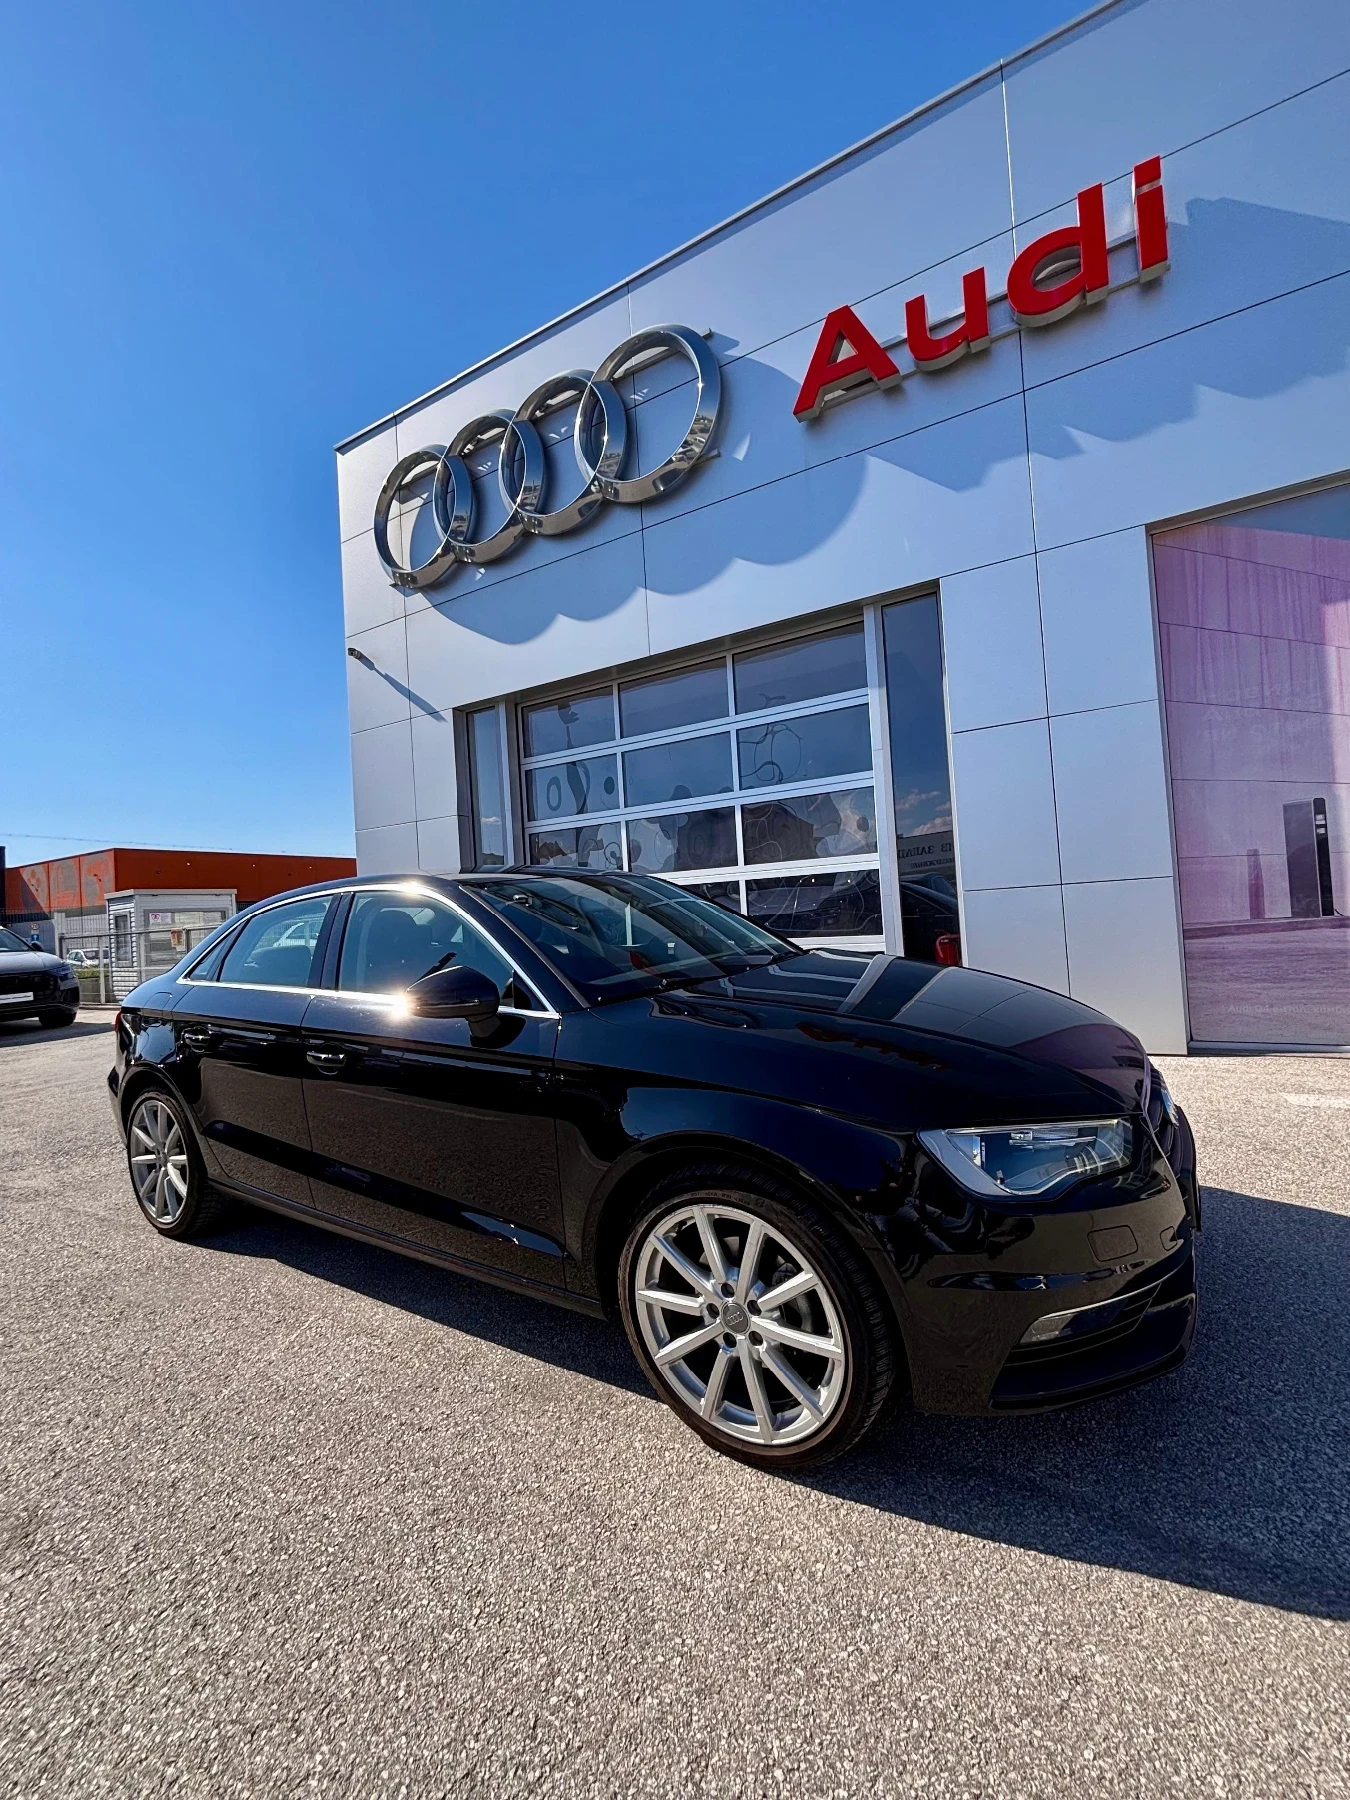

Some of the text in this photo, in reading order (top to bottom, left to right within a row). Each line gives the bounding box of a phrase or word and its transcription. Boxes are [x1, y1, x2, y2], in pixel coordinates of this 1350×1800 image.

[793, 155, 1169, 422] Audi
[1228, 1004, 1252, 1014] Audi
[1255, 1004, 1271, 1014] Q4
